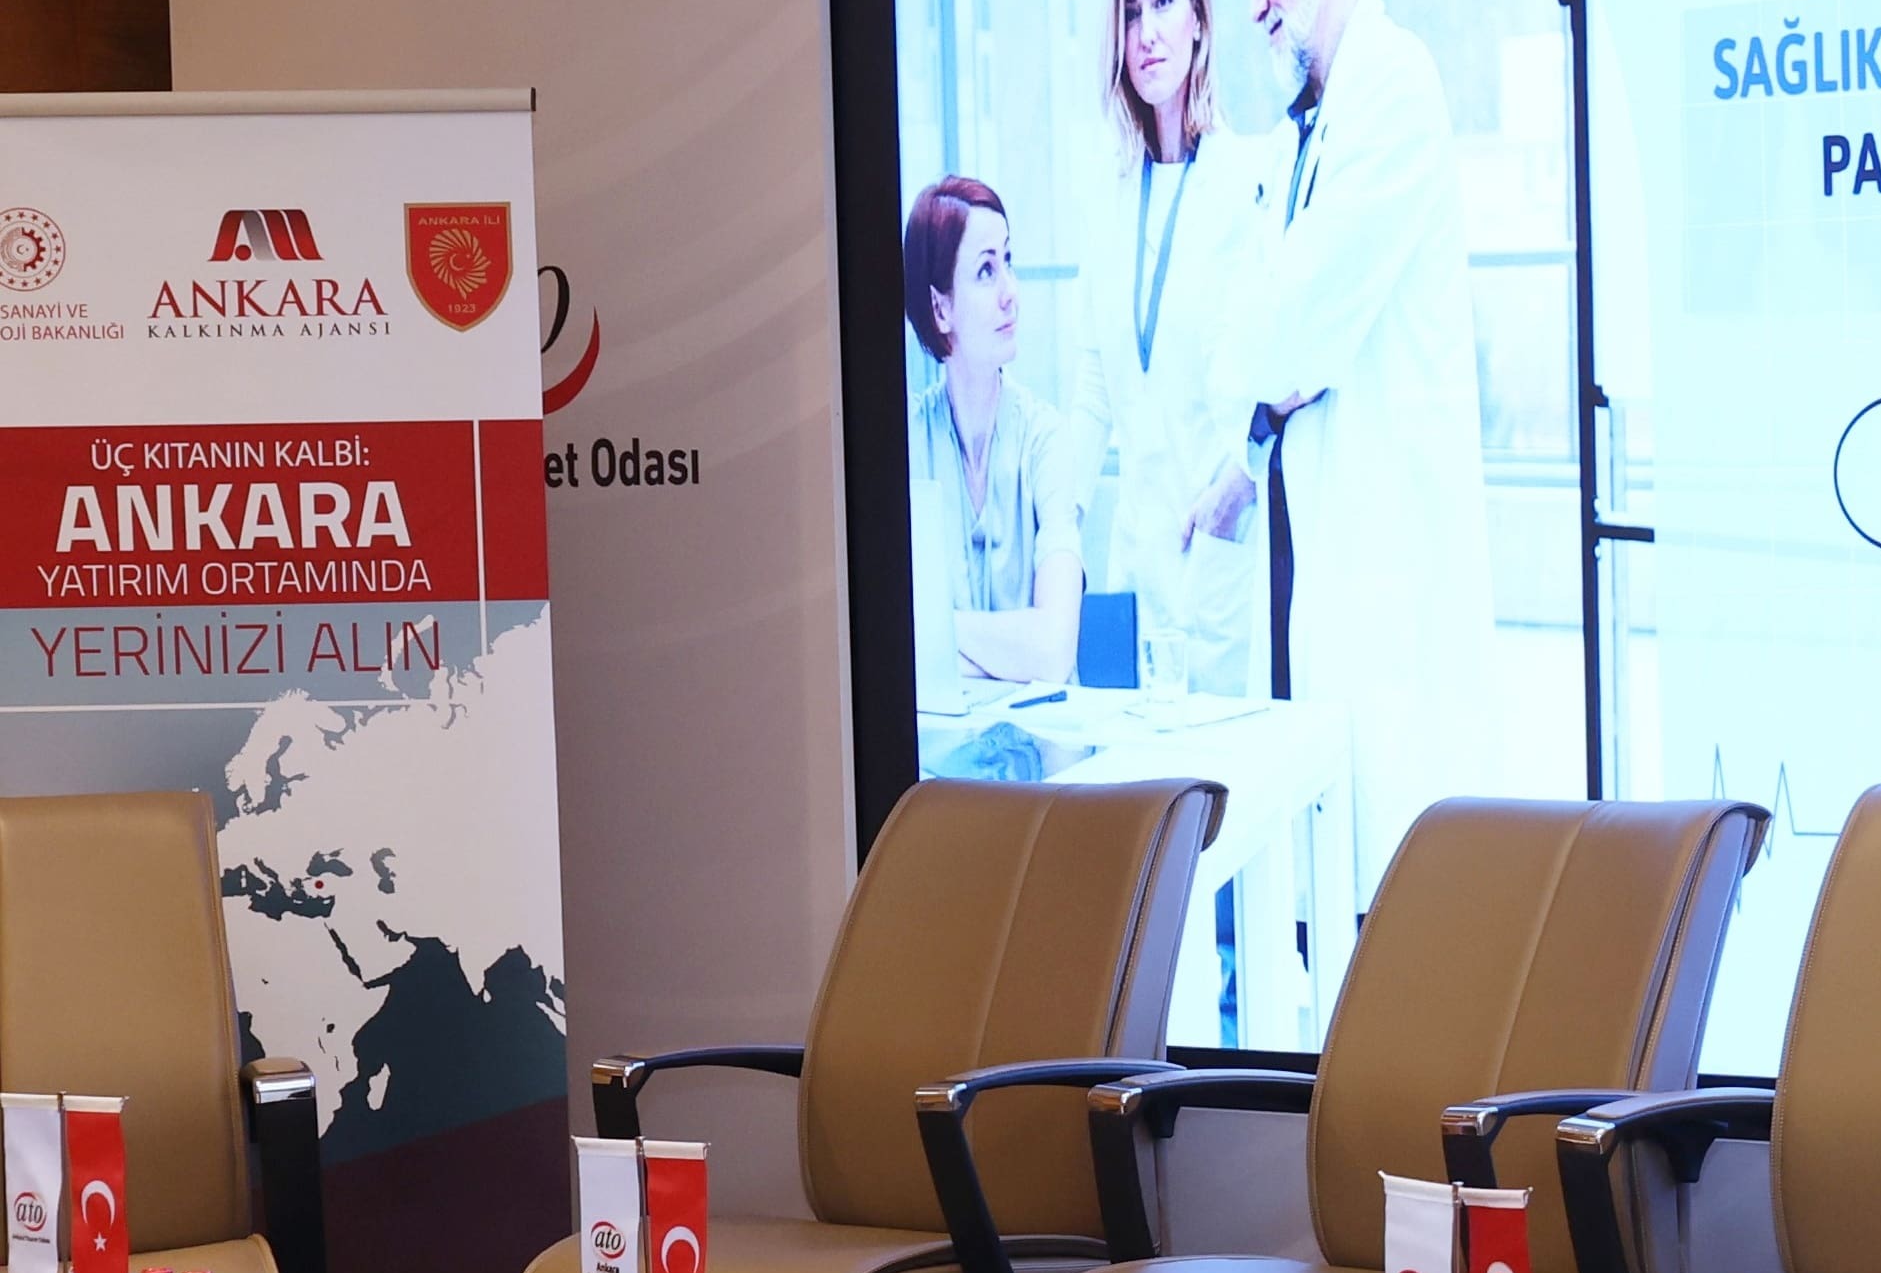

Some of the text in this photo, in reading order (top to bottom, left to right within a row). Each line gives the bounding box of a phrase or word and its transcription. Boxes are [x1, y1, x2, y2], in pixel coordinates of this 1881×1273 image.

[418, 215, 480, 226] ANKARA
[149, 278, 387, 318] ANKARA
[446, 302, 478, 314] 1923
[0, 301, 89, 320] SANAYİ VE
[31, 322, 125, 341] BAKANLIĞI
[146, 321, 391, 340] KALKINMA AJANSI
[92, 435, 369, 476] ÜÇ KITANIN KALBİ:
[592, 438, 699, 487] Odası
[56, 481, 411, 552] ANKARA
[38, 560, 431, 597] YATIRIM ORTAMINDA
[31, 611, 441, 677] YERİNİZİ ALIN
[16, 1201, 43, 1224] ato
[594, 1229, 622, 1250] ato
